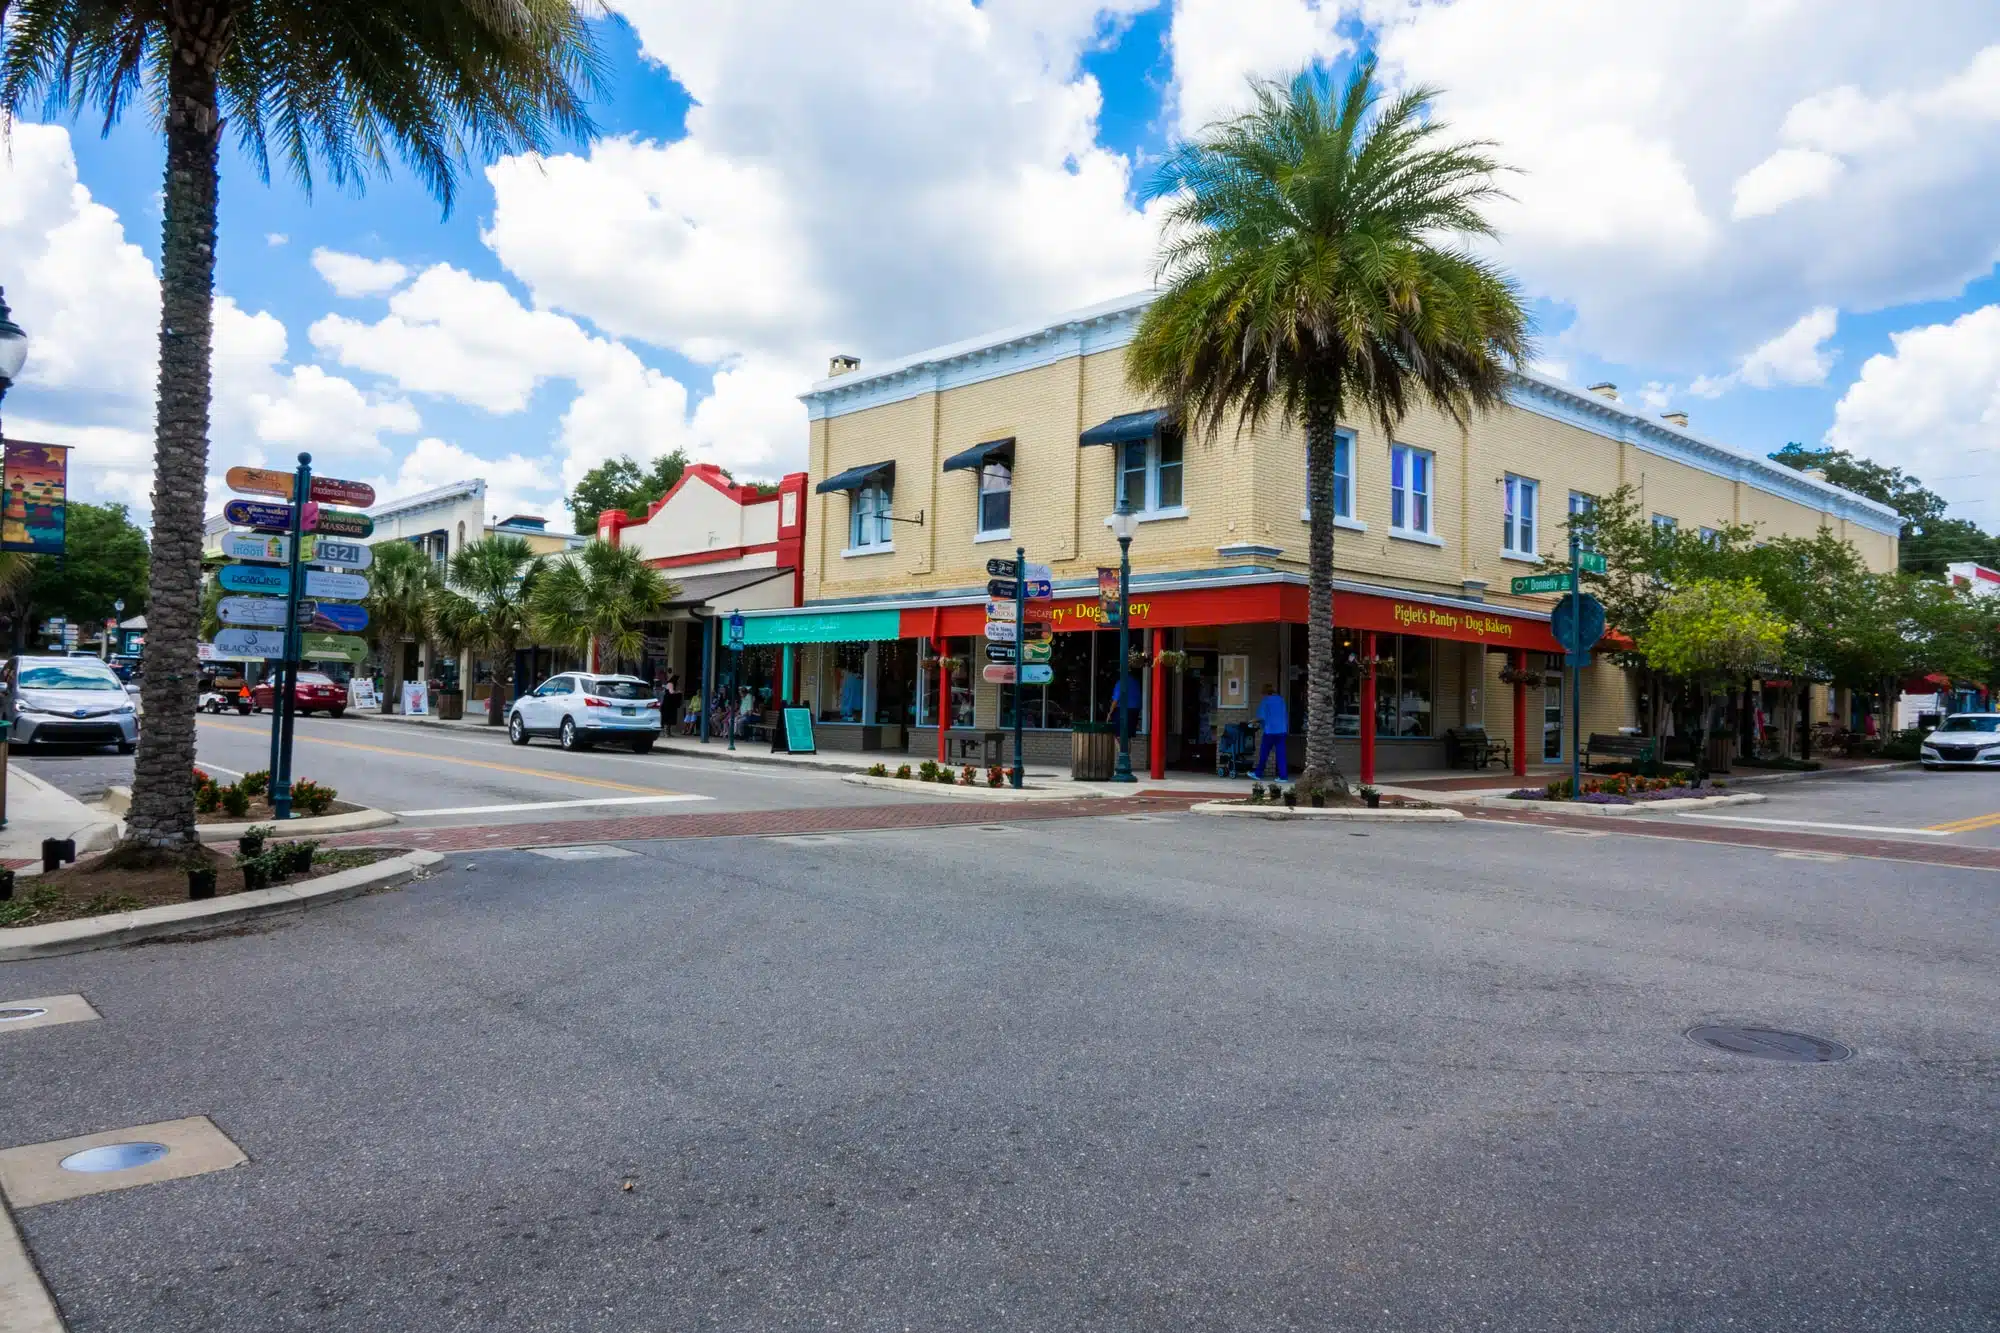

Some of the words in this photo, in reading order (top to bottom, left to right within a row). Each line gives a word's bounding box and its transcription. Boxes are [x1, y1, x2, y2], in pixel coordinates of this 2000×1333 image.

[312, 486, 346, 497] modernism
[320, 522, 363, 534] MASSAGE
[232, 547, 264, 557] moon
[319, 544, 357, 562] 1921
[231, 574, 282, 586] DOWLING
[1530, 578, 1558, 591] Donnelly
[1076, 603, 1101, 623] Dog
[1394, 604, 1428, 627] Piglet's
[1429, 609, 1459, 632] Pantry
[1465, 615, 1484, 635] Dog
[1485, 617, 1513, 639] Bakery
[218, 643, 251, 654] BLACK
[254, 644, 281, 655] SWAN
